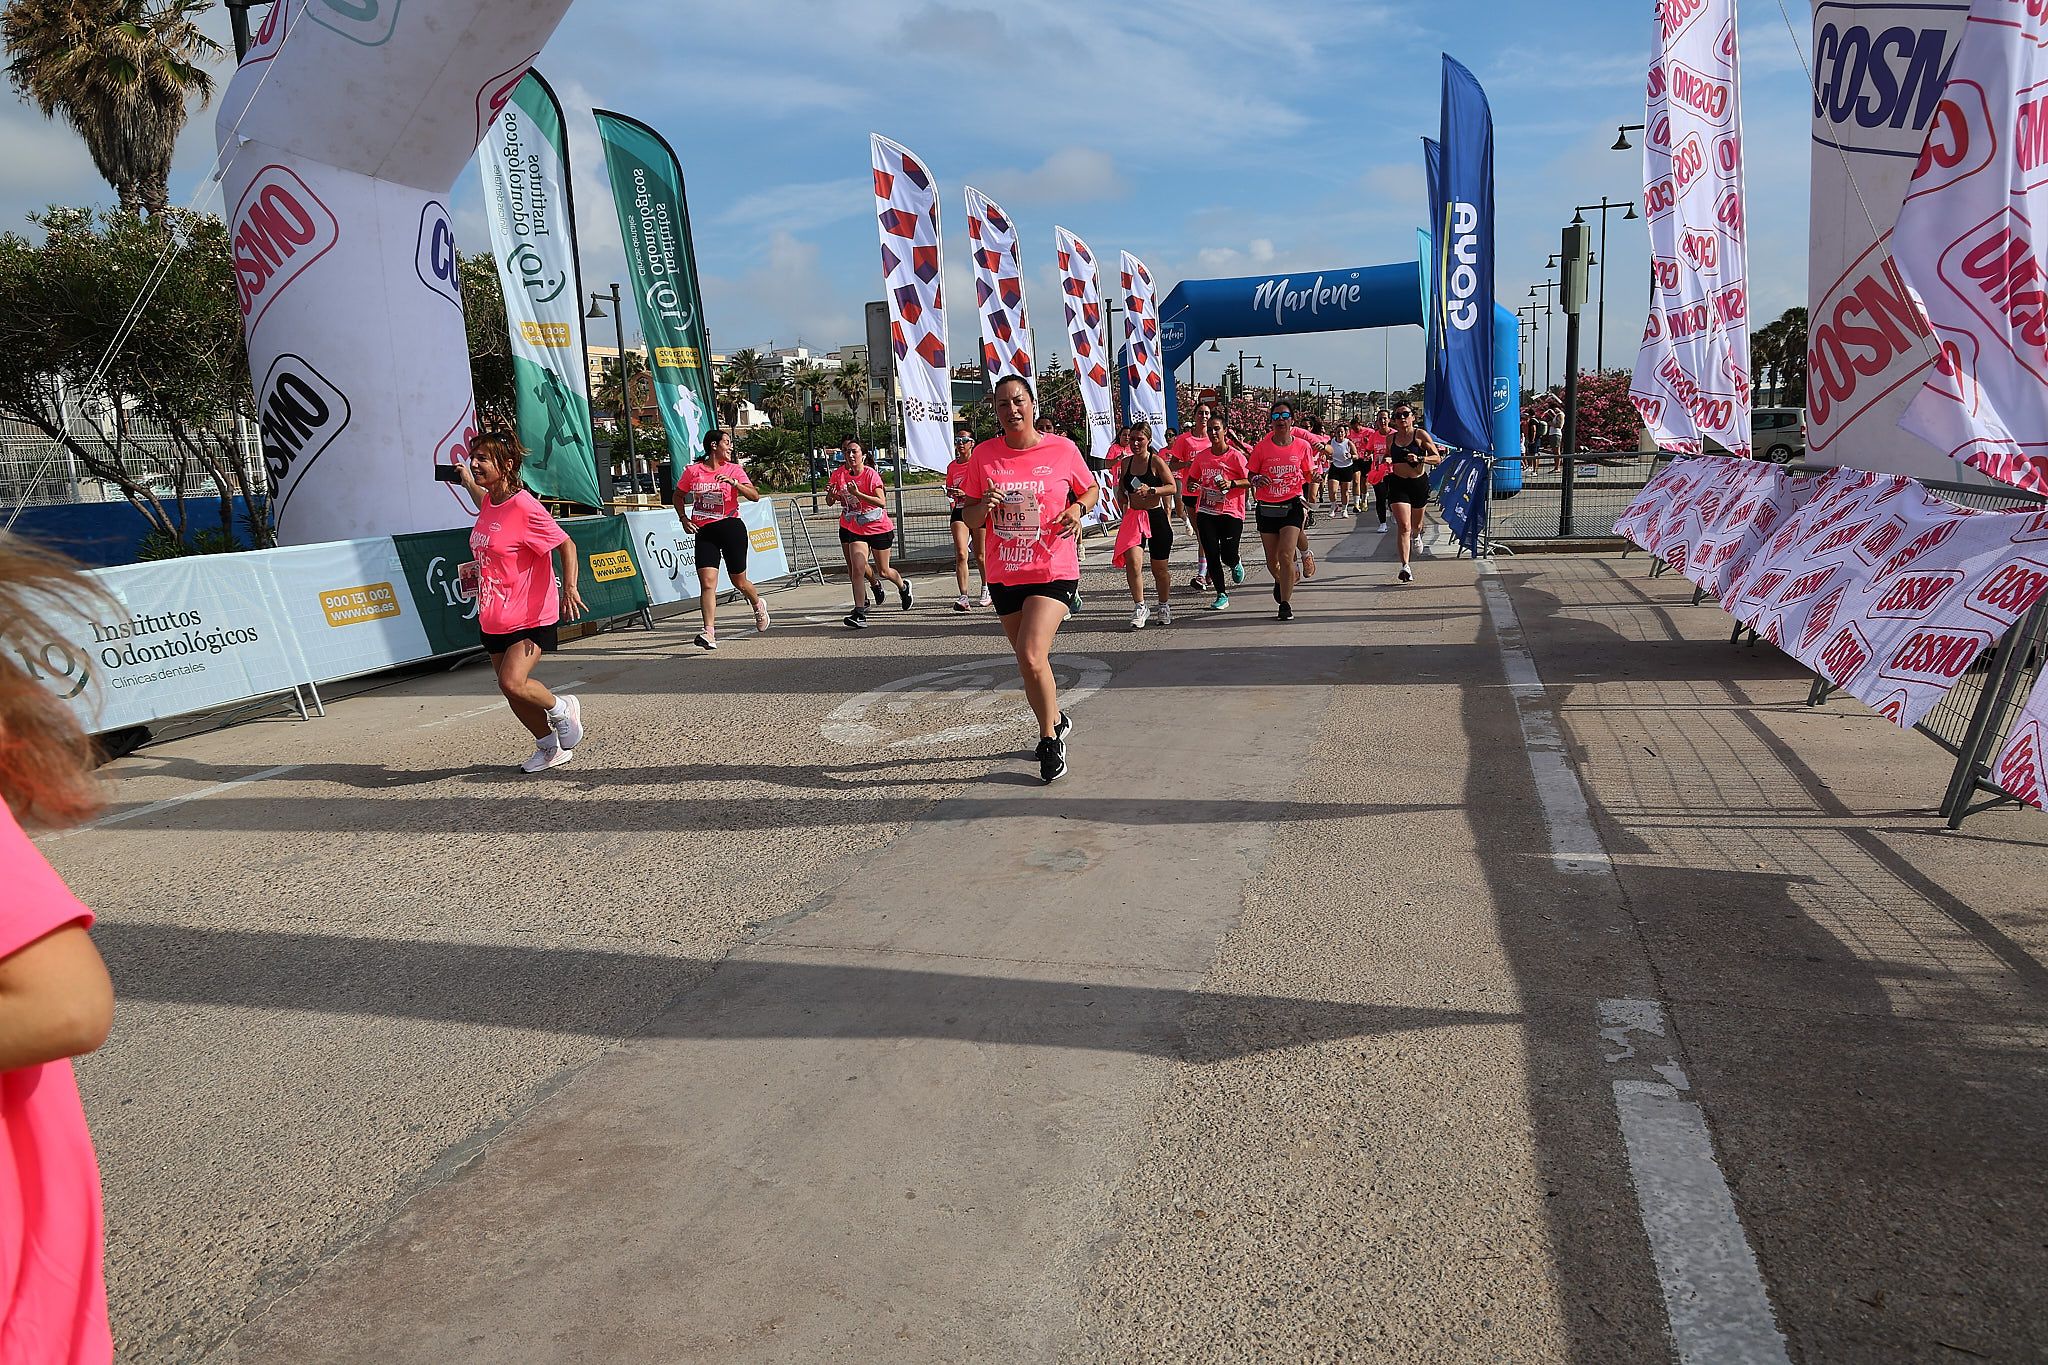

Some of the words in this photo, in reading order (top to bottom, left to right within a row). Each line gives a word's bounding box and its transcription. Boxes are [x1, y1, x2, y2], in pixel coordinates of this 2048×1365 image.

[1006, 512, 1026, 521] 016
[592, 558, 606, 568] 900
[605, 557, 617, 566] 131
[617, 554, 628, 564] 002
[999, 546, 1033, 562] MUJER
[596, 565, 632, 577] www.ioa.es
[325, 595, 349, 609] 900
[351, 592, 368, 605] 131
[369, 588, 391, 601] 002
[1876, 577, 1955, 612] COSMO
[331, 602, 395, 621] www.ioa.es
[88, 608, 202, 643] Institutos
[100, 626, 259, 669] Odontológicos
[1891, 633, 1980, 678] COSMO
[111, 672, 158, 690] Clínicas
[157, 661, 206, 681] dentales
